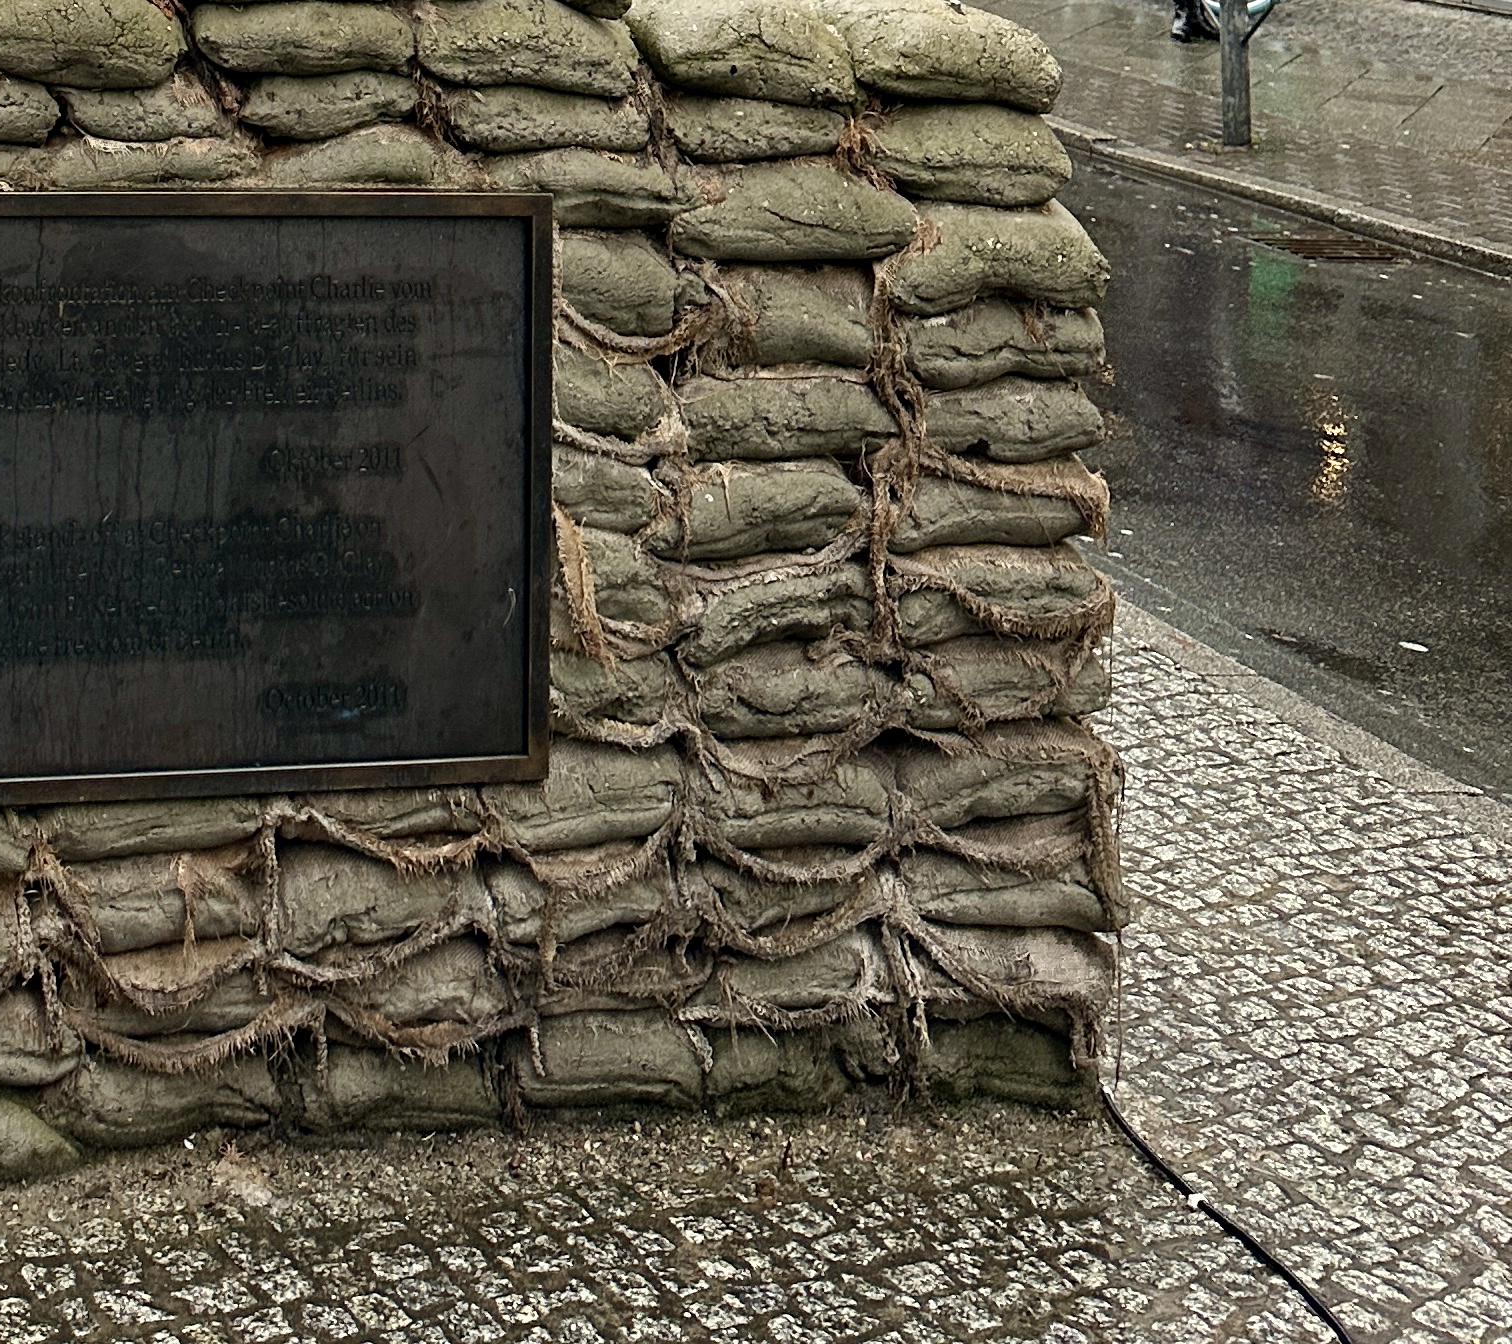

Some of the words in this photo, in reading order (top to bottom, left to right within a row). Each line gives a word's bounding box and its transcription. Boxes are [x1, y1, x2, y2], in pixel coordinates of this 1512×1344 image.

[309, 272, 384, 301] Charlie
[391, 278, 433, 300] vom
[384, 308, 417, 333] des
[375, 341, 417, 366] sein
[357, 444, 402, 474] 2011
